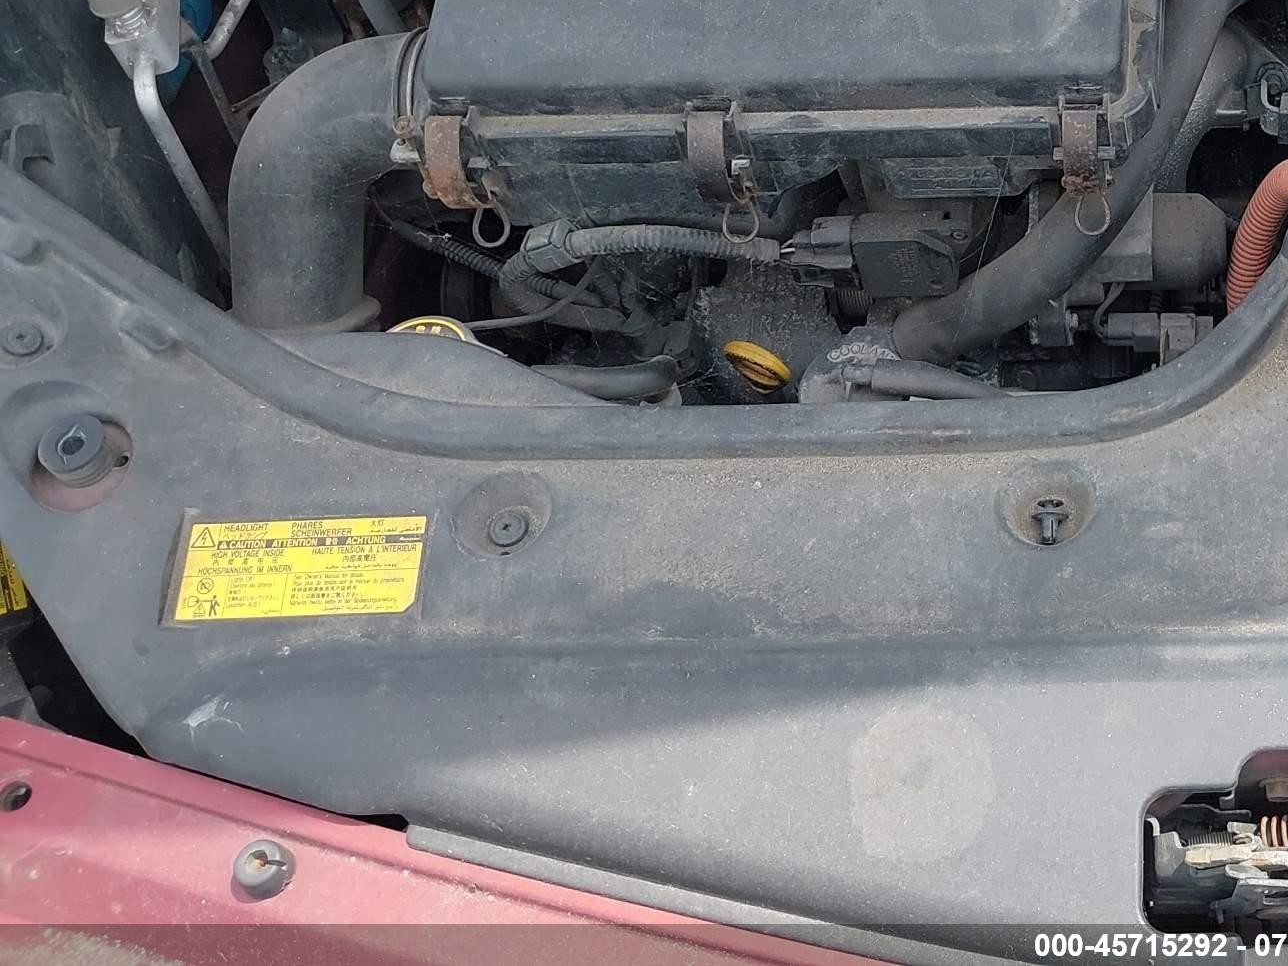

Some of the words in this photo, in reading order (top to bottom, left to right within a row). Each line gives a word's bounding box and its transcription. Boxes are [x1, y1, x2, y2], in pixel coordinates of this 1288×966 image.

[224, 523, 269, 533] HEADLIGHT
[291, 521, 323, 530] PHARES
[291, 528, 353, 538] SCHEINWERFER
[230, 541, 267, 549] CAUTION
[271, 538, 318, 548] ATTENTION
[345, 536, 386, 545] ACHTUNG
[211, 551, 229, 559] HIGH
[230, 550, 261, 558] VOLTAGE
[263, 549, 285, 557] INSIDE
[312, 547, 334, 555] HAUTE
[337, 546, 365, 555] TENSION
[198, 565, 254, 574] HOCHSPANNUNG
[256, 564, 265, 573] IM
[267, 564, 293, 573] INNERN
